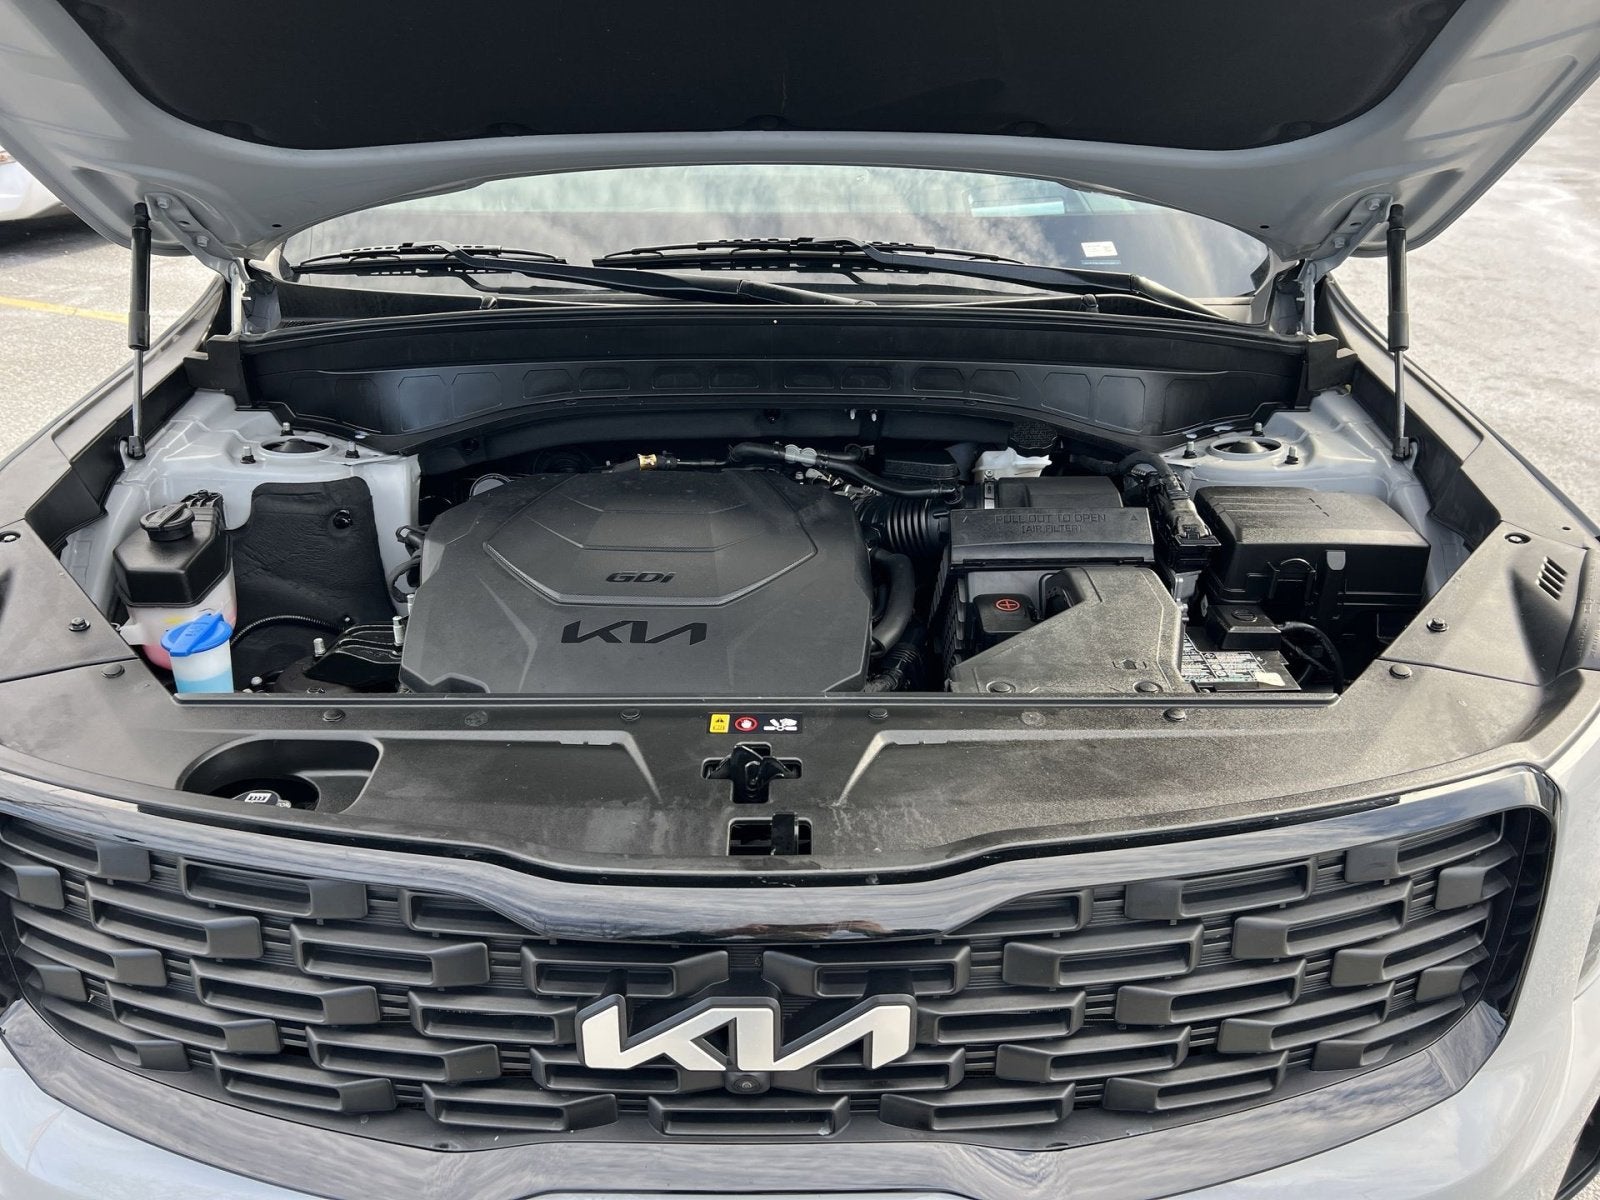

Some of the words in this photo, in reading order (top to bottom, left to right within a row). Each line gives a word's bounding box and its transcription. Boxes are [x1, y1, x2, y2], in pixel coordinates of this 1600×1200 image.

[995, 514, 1027, 524] PULL
[1028, 513, 1055, 523] OUT
[1057, 513, 1071, 523] TO
[1074, 512, 1106, 523] OPEN
[561, 620, 707, 645] KIA
[581, 1004, 911, 1071] KIA
